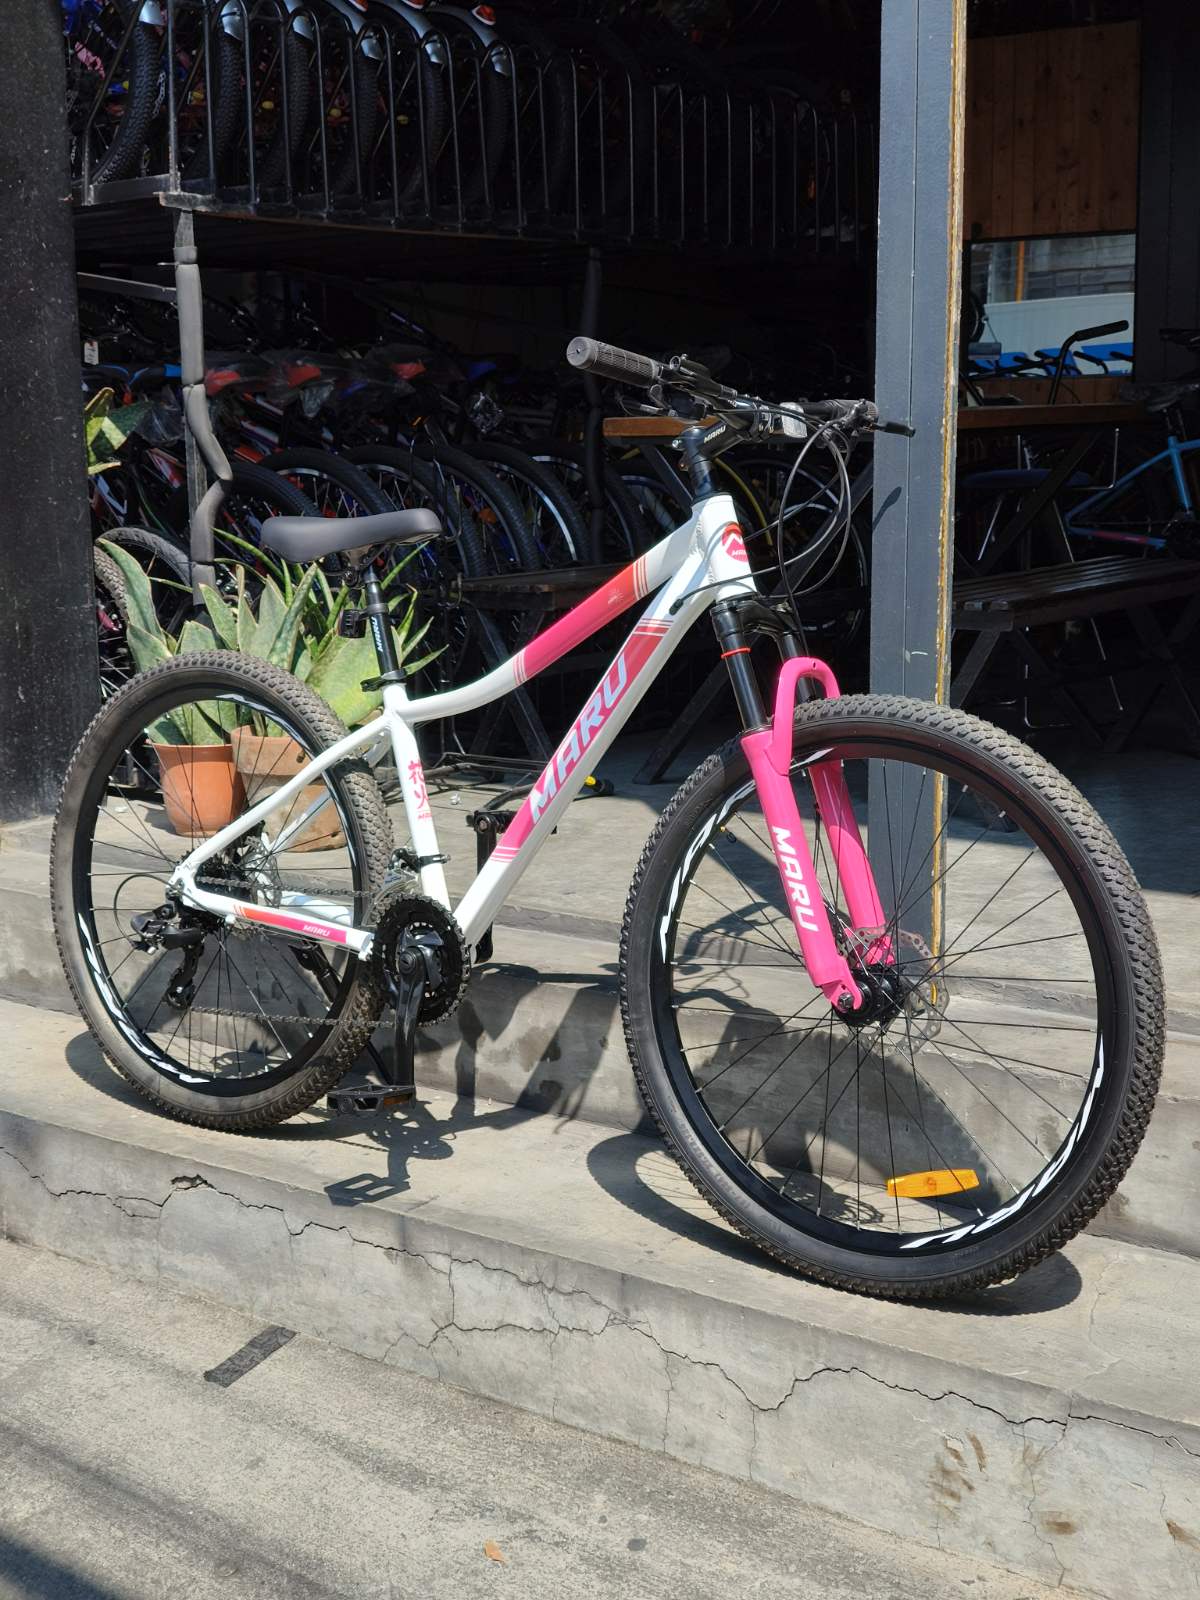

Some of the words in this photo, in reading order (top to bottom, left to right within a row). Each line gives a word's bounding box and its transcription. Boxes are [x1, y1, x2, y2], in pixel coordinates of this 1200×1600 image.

[703, 425, 726, 444] MARU
[530, 653, 627, 825] MARU
[772, 825, 819, 932] MARU
[302, 924, 331, 937] MARU
